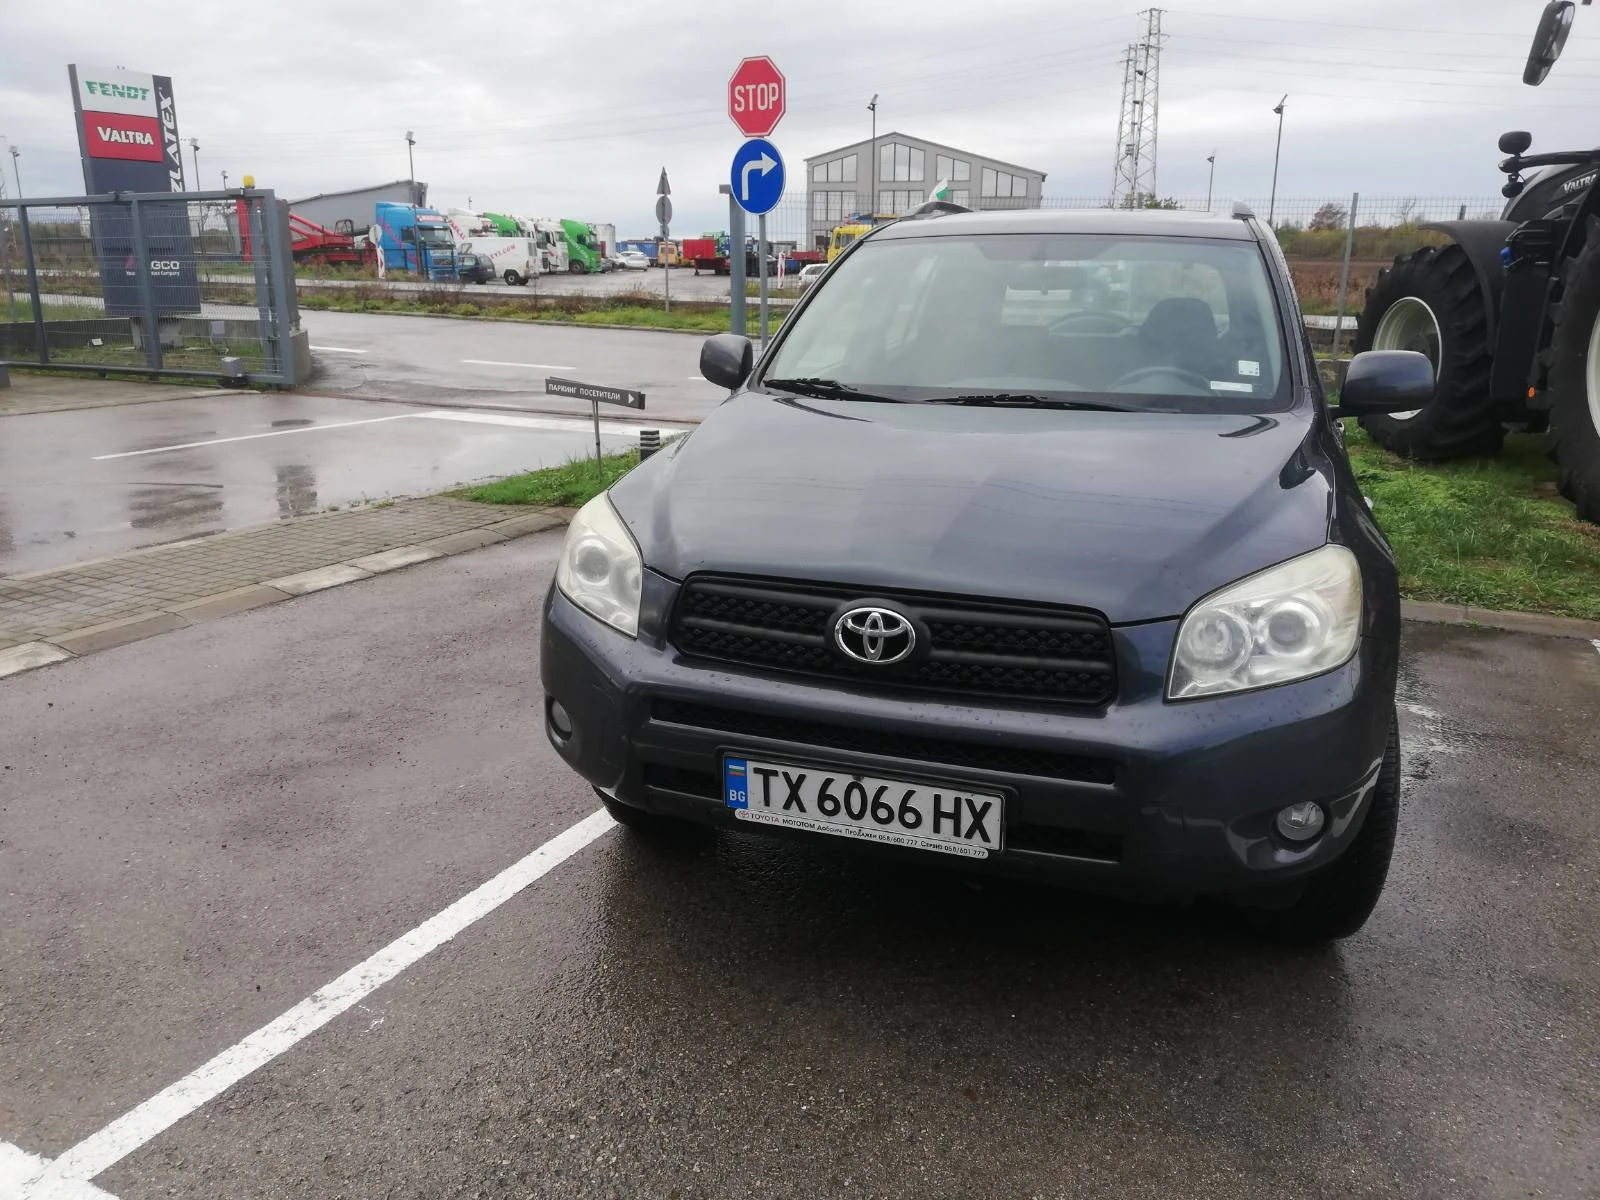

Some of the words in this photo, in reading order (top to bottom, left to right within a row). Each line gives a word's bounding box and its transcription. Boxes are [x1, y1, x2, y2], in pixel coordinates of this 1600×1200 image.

[85, 80, 149, 102] FENDT
[734, 83, 779, 112] STOP
[97, 125, 154, 146] VALTRA
[548, 383, 577, 394] ПАРКИНГ
[579, 388, 621, 400] ПОСЕТИТЕЛИ
[729, 788, 747, 802] BG
[752, 767, 807, 814] TX
[816, 777, 923, 830] 6066
[932, 793, 993, 844] HX
[751, 812, 780, 824] TOYOTA
[906, 837, 917, 846] 777
[973, 849, 986, 858] 777
